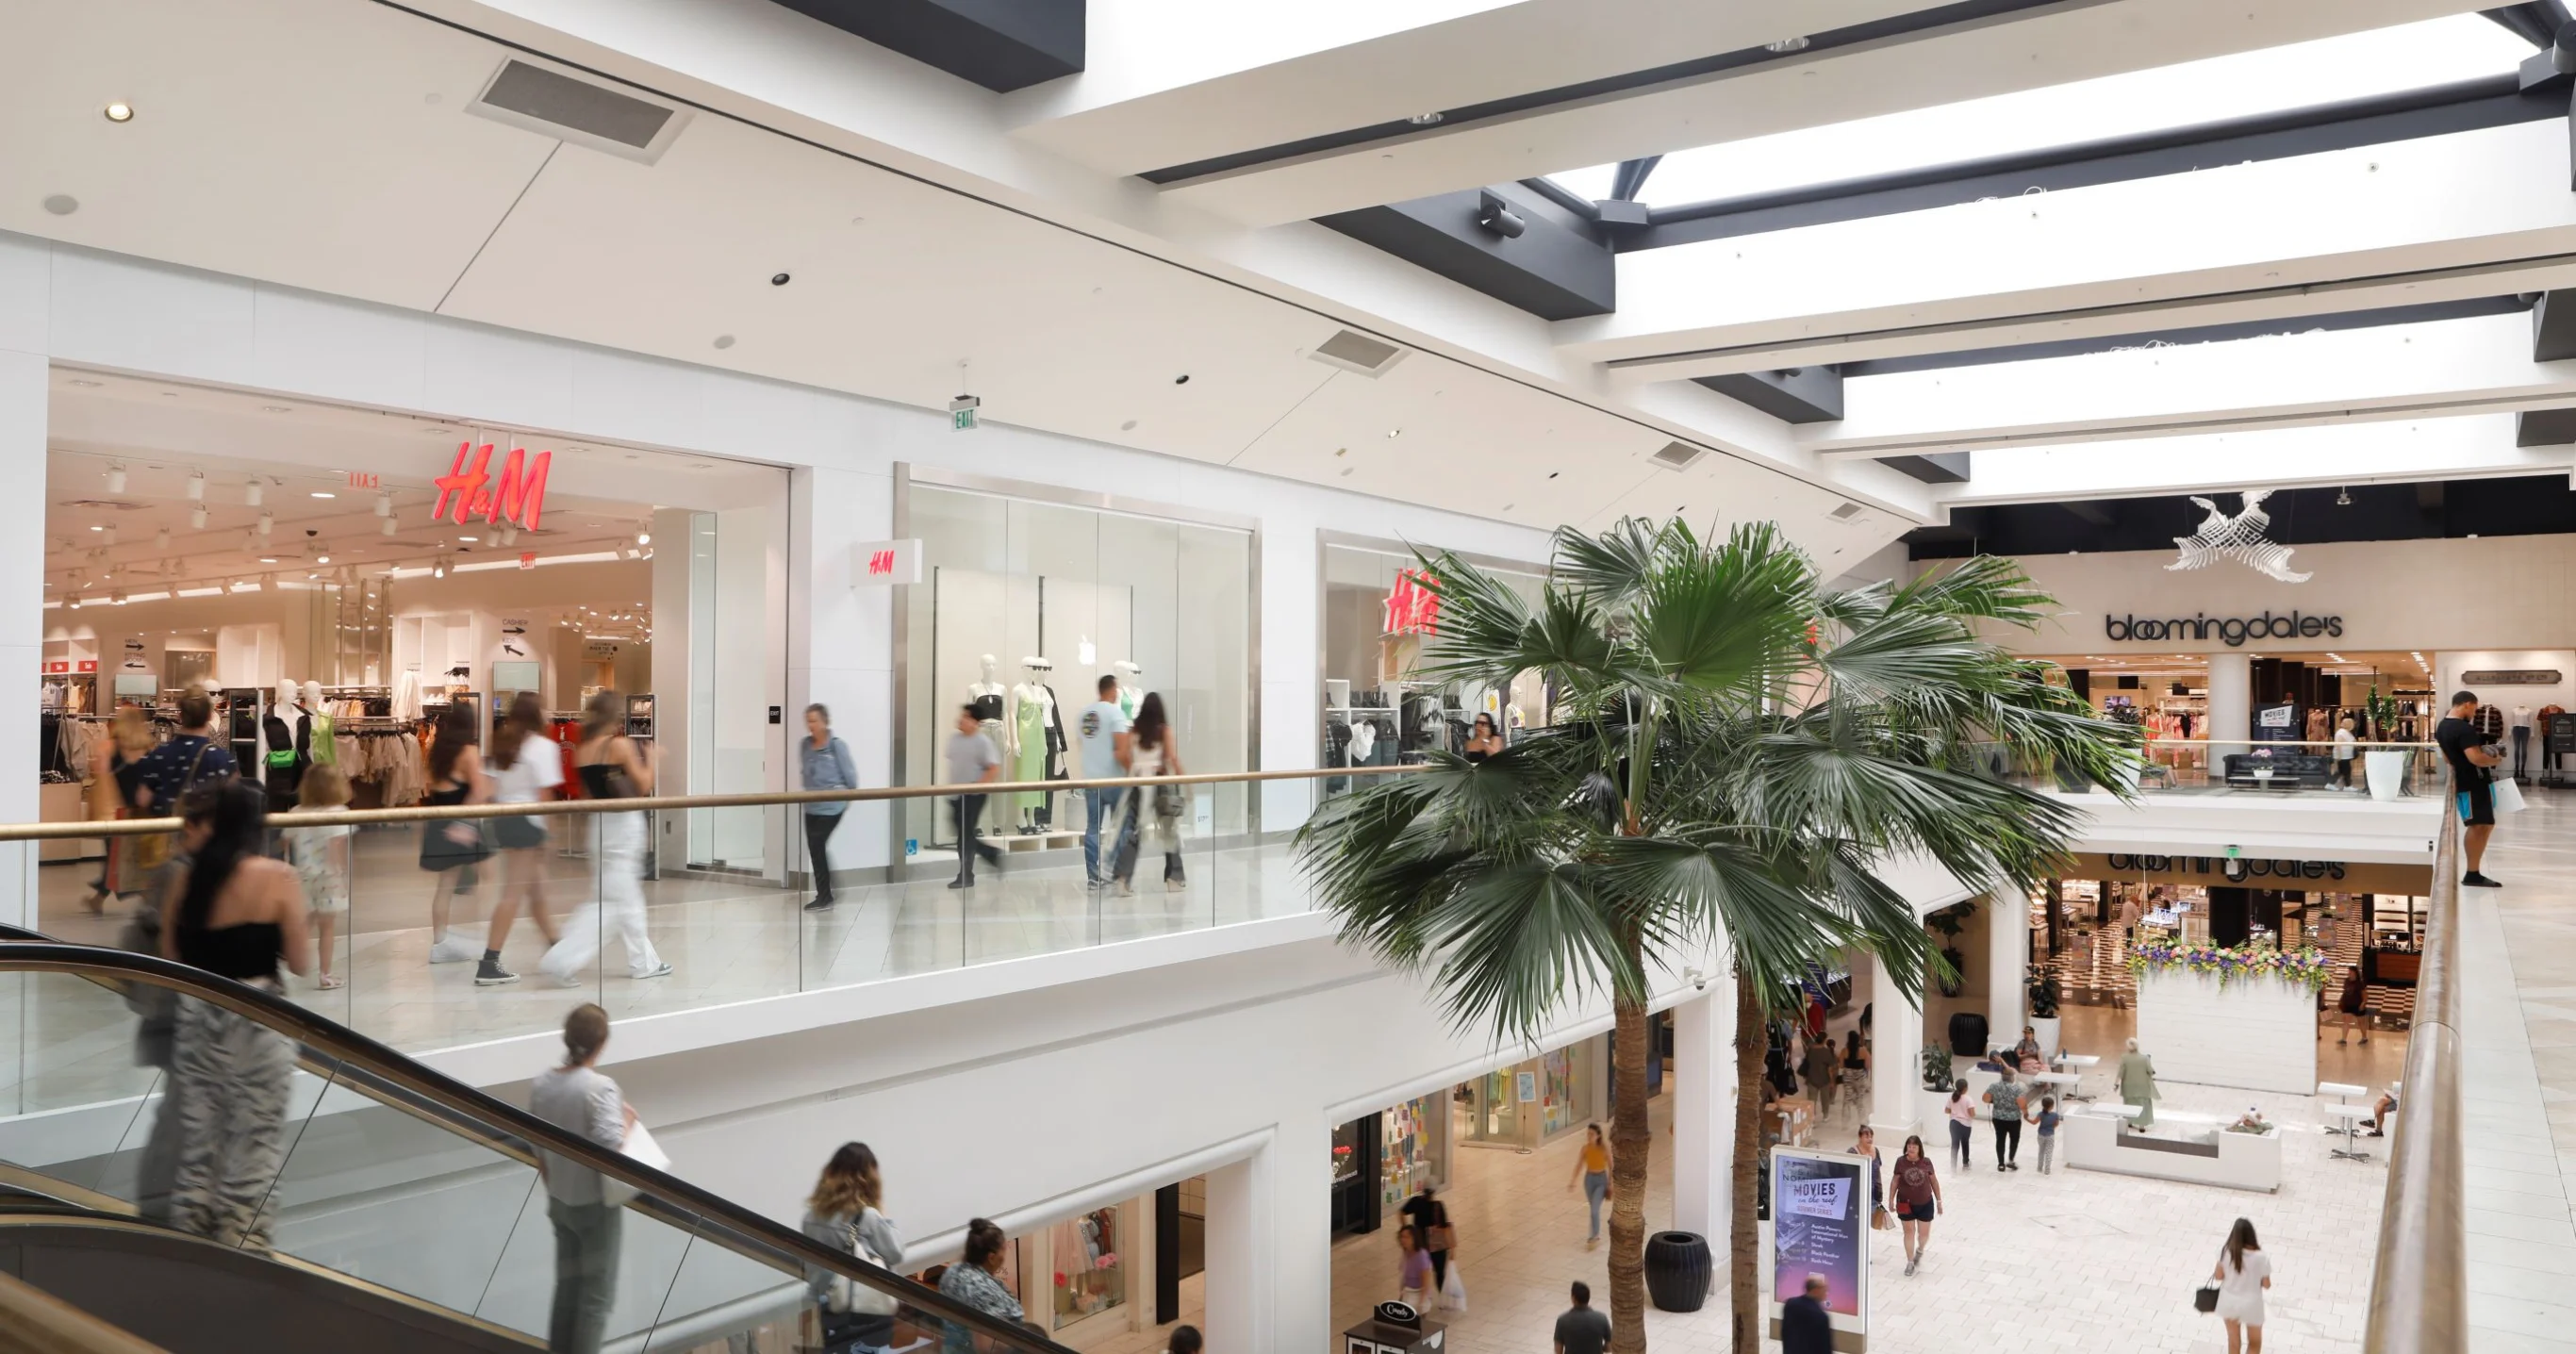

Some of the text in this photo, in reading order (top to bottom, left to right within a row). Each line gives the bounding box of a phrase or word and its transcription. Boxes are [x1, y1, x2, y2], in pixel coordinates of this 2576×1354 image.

[955, 408, 974, 429] EXIT
[433, 441, 552, 533] H&M
[868, 550, 895, 575] H&M
[2105, 610, 2343, 648] bloomingdale's
[1793, 1182, 1836, 1196] MOVIES
[1386, 1303, 1409, 1317] Candy
